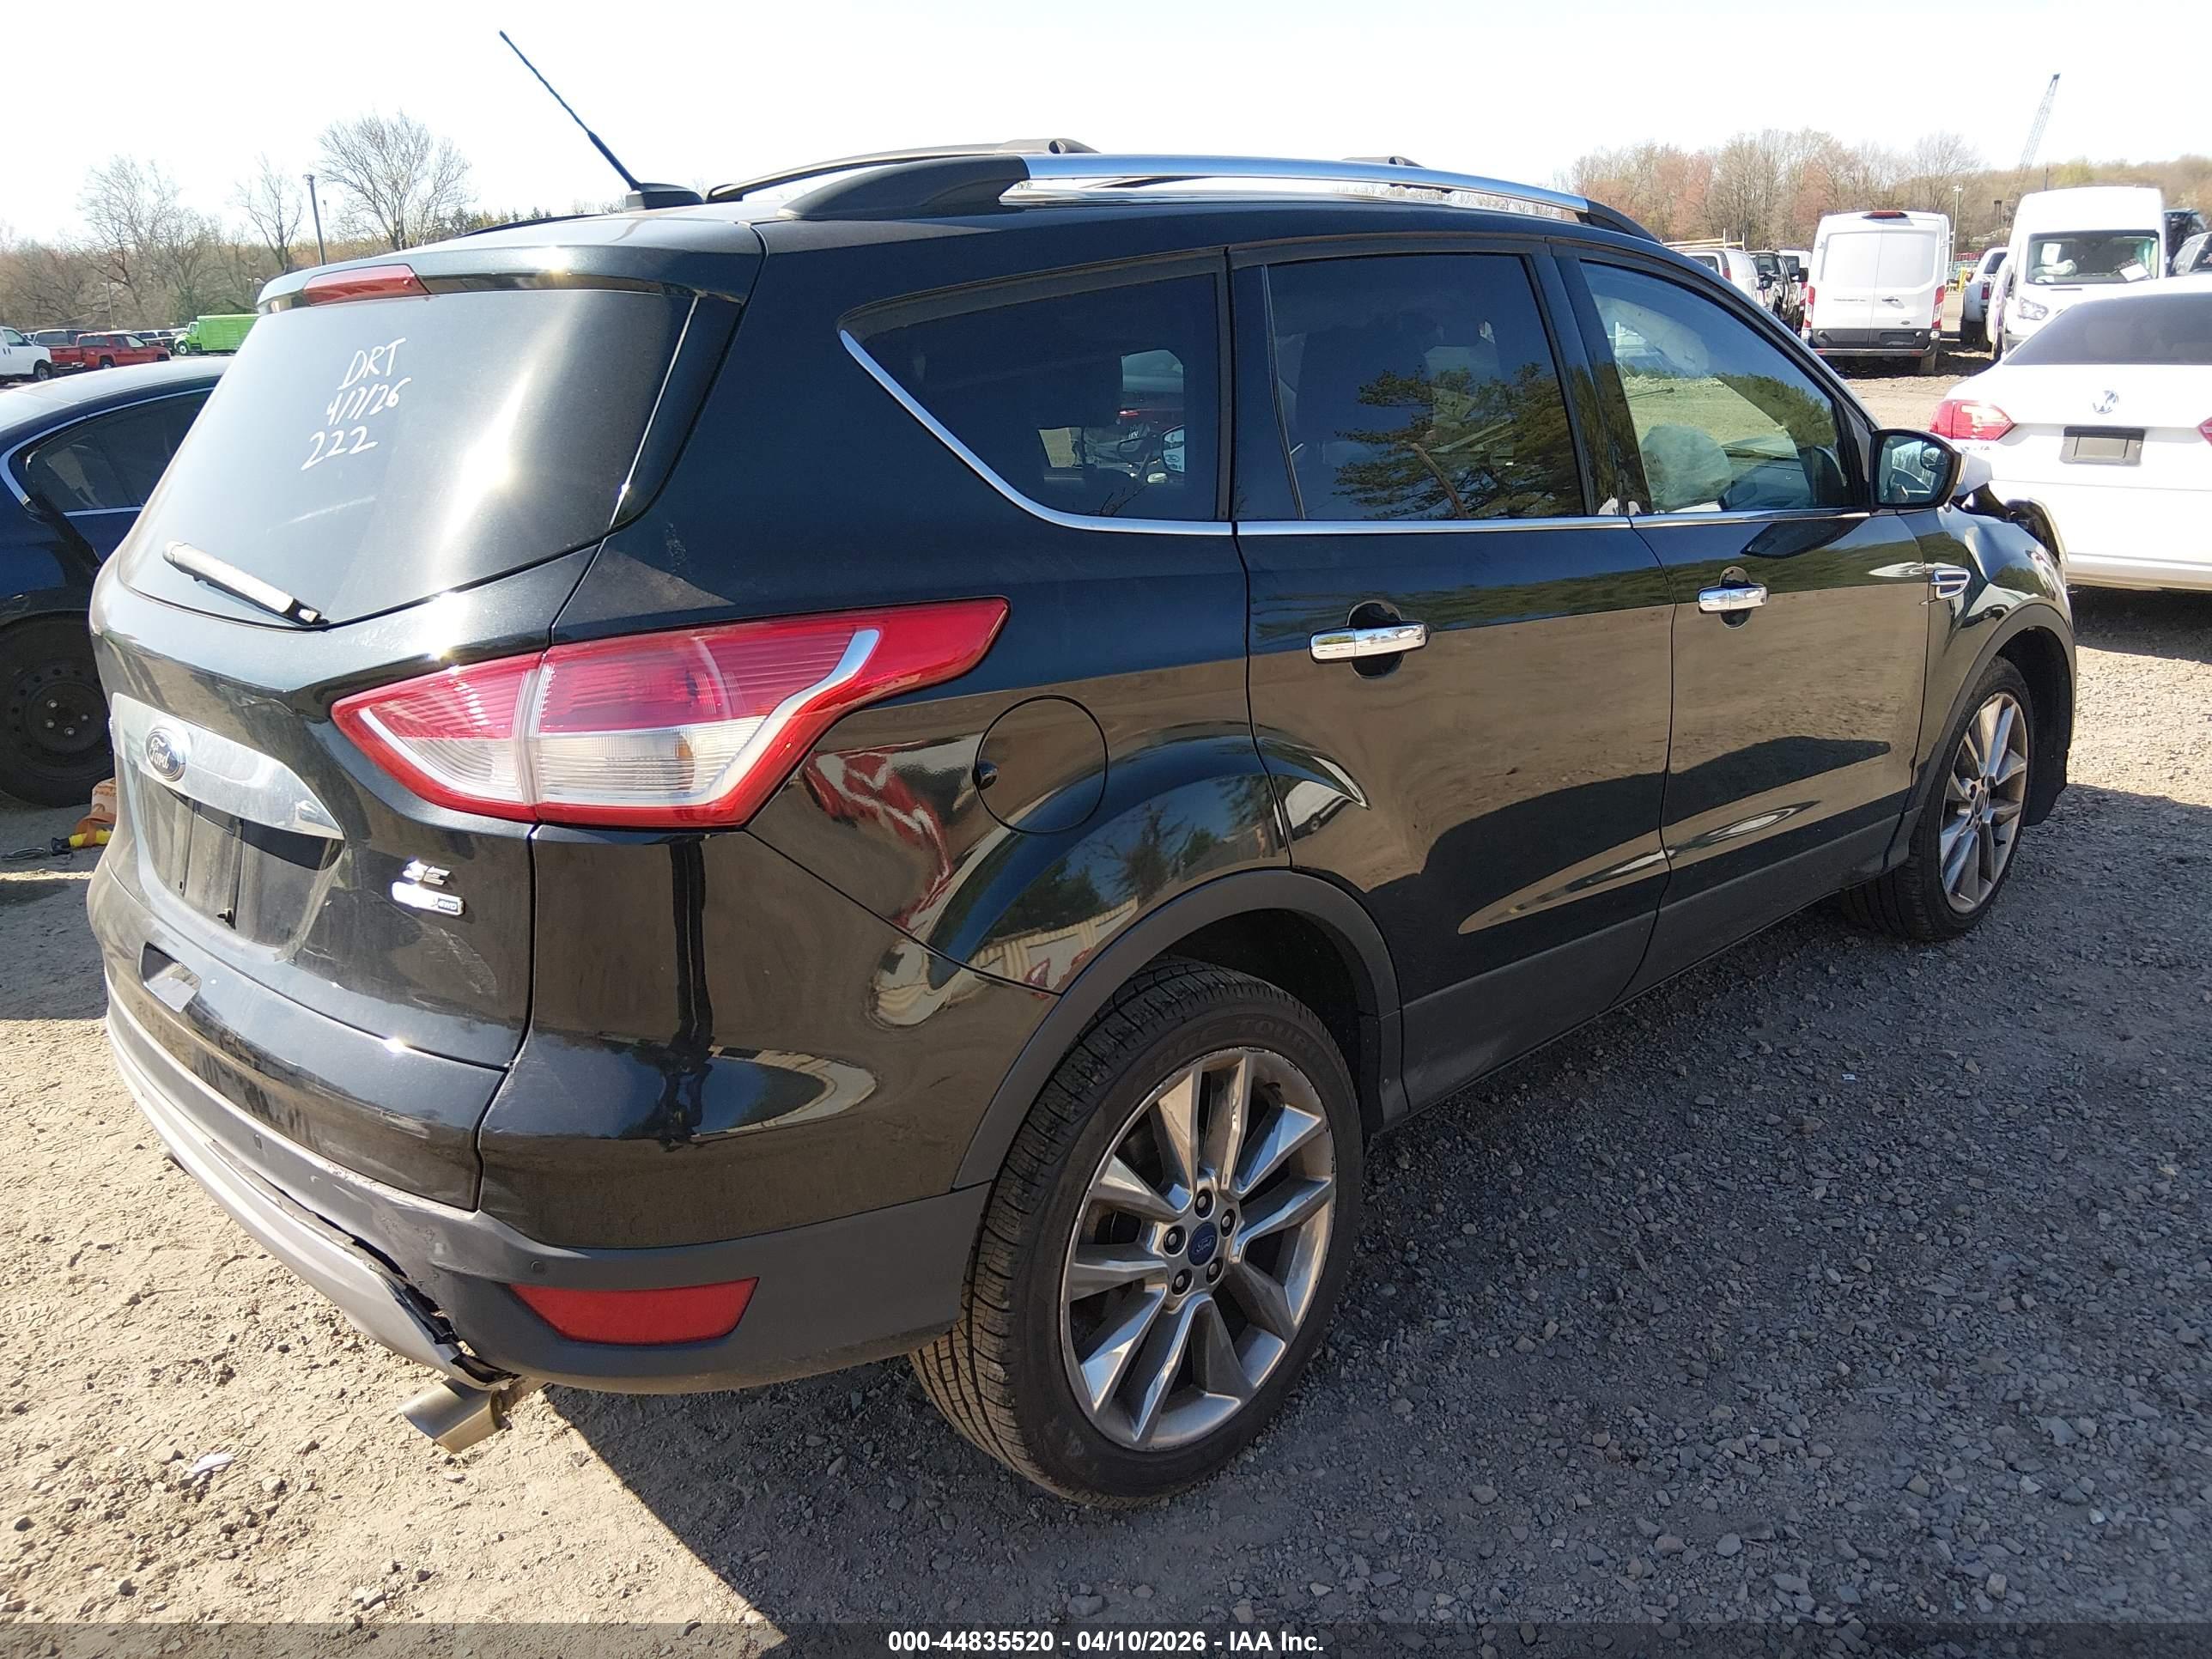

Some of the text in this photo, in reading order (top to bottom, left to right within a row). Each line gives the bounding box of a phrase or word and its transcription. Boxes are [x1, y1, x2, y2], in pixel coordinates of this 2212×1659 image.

[337, 337, 407, 390] DRT
[301, 425, 378, 471] 222
[149, 737, 170, 769] Ford
